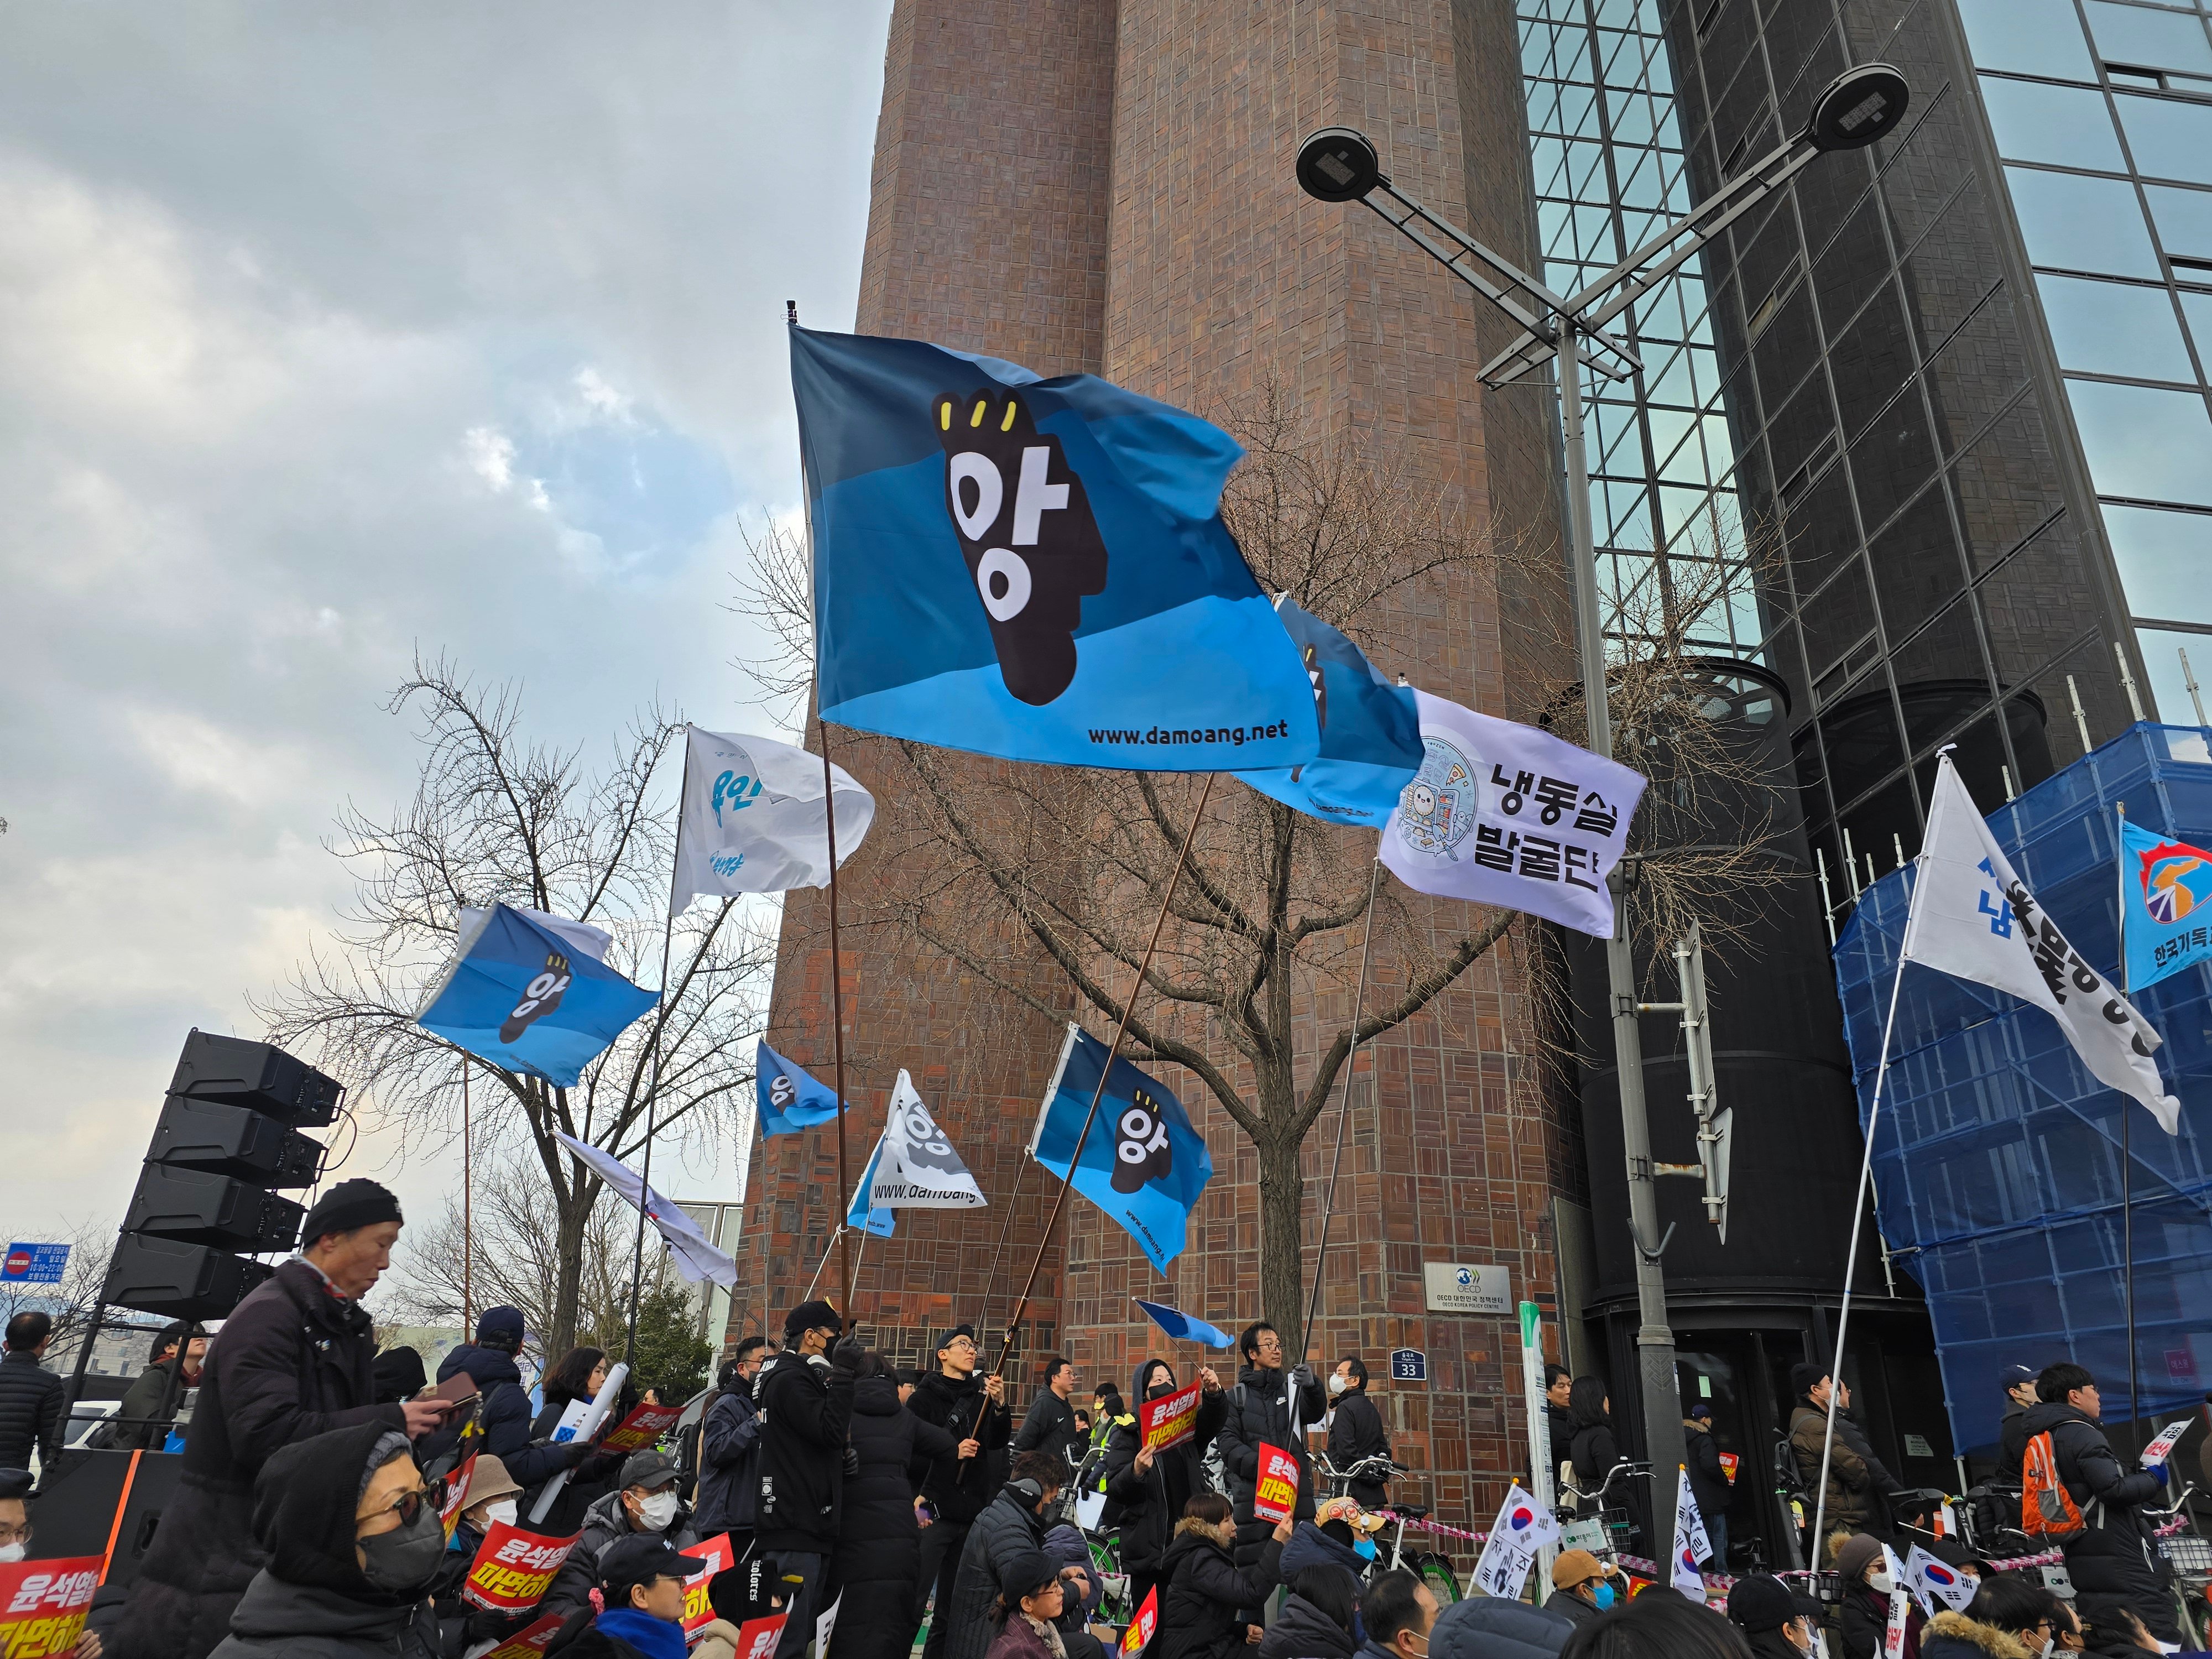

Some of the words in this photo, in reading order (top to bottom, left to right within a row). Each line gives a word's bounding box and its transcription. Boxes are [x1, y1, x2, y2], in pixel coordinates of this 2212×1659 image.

[950, 446, 1071, 622] 앙
[1088, 719, 1289, 745] www.damoang.net
[1491, 764, 1618, 838] 냉동실
[1475, 823, 1600, 893] 발굴단
[2154, 925, 2212, 968] 한국기독
[512, 972, 571, 1018] 앙
[1118, 1109, 1168, 1164] 앙
[27, 1272, 61, 1281] 보행전용거리
[29, 1264, 64, 1272] 10:00~22:00
[1457, 1284, 1481, 1293] OECD
[1401, 1364, 1416, 1376] 33
[1151, 1390, 1197, 1427] 윤석열을
[1576, 1532, 1592, 1543] 따릉이
[6, 1571, 99, 1614] 윤석열을
